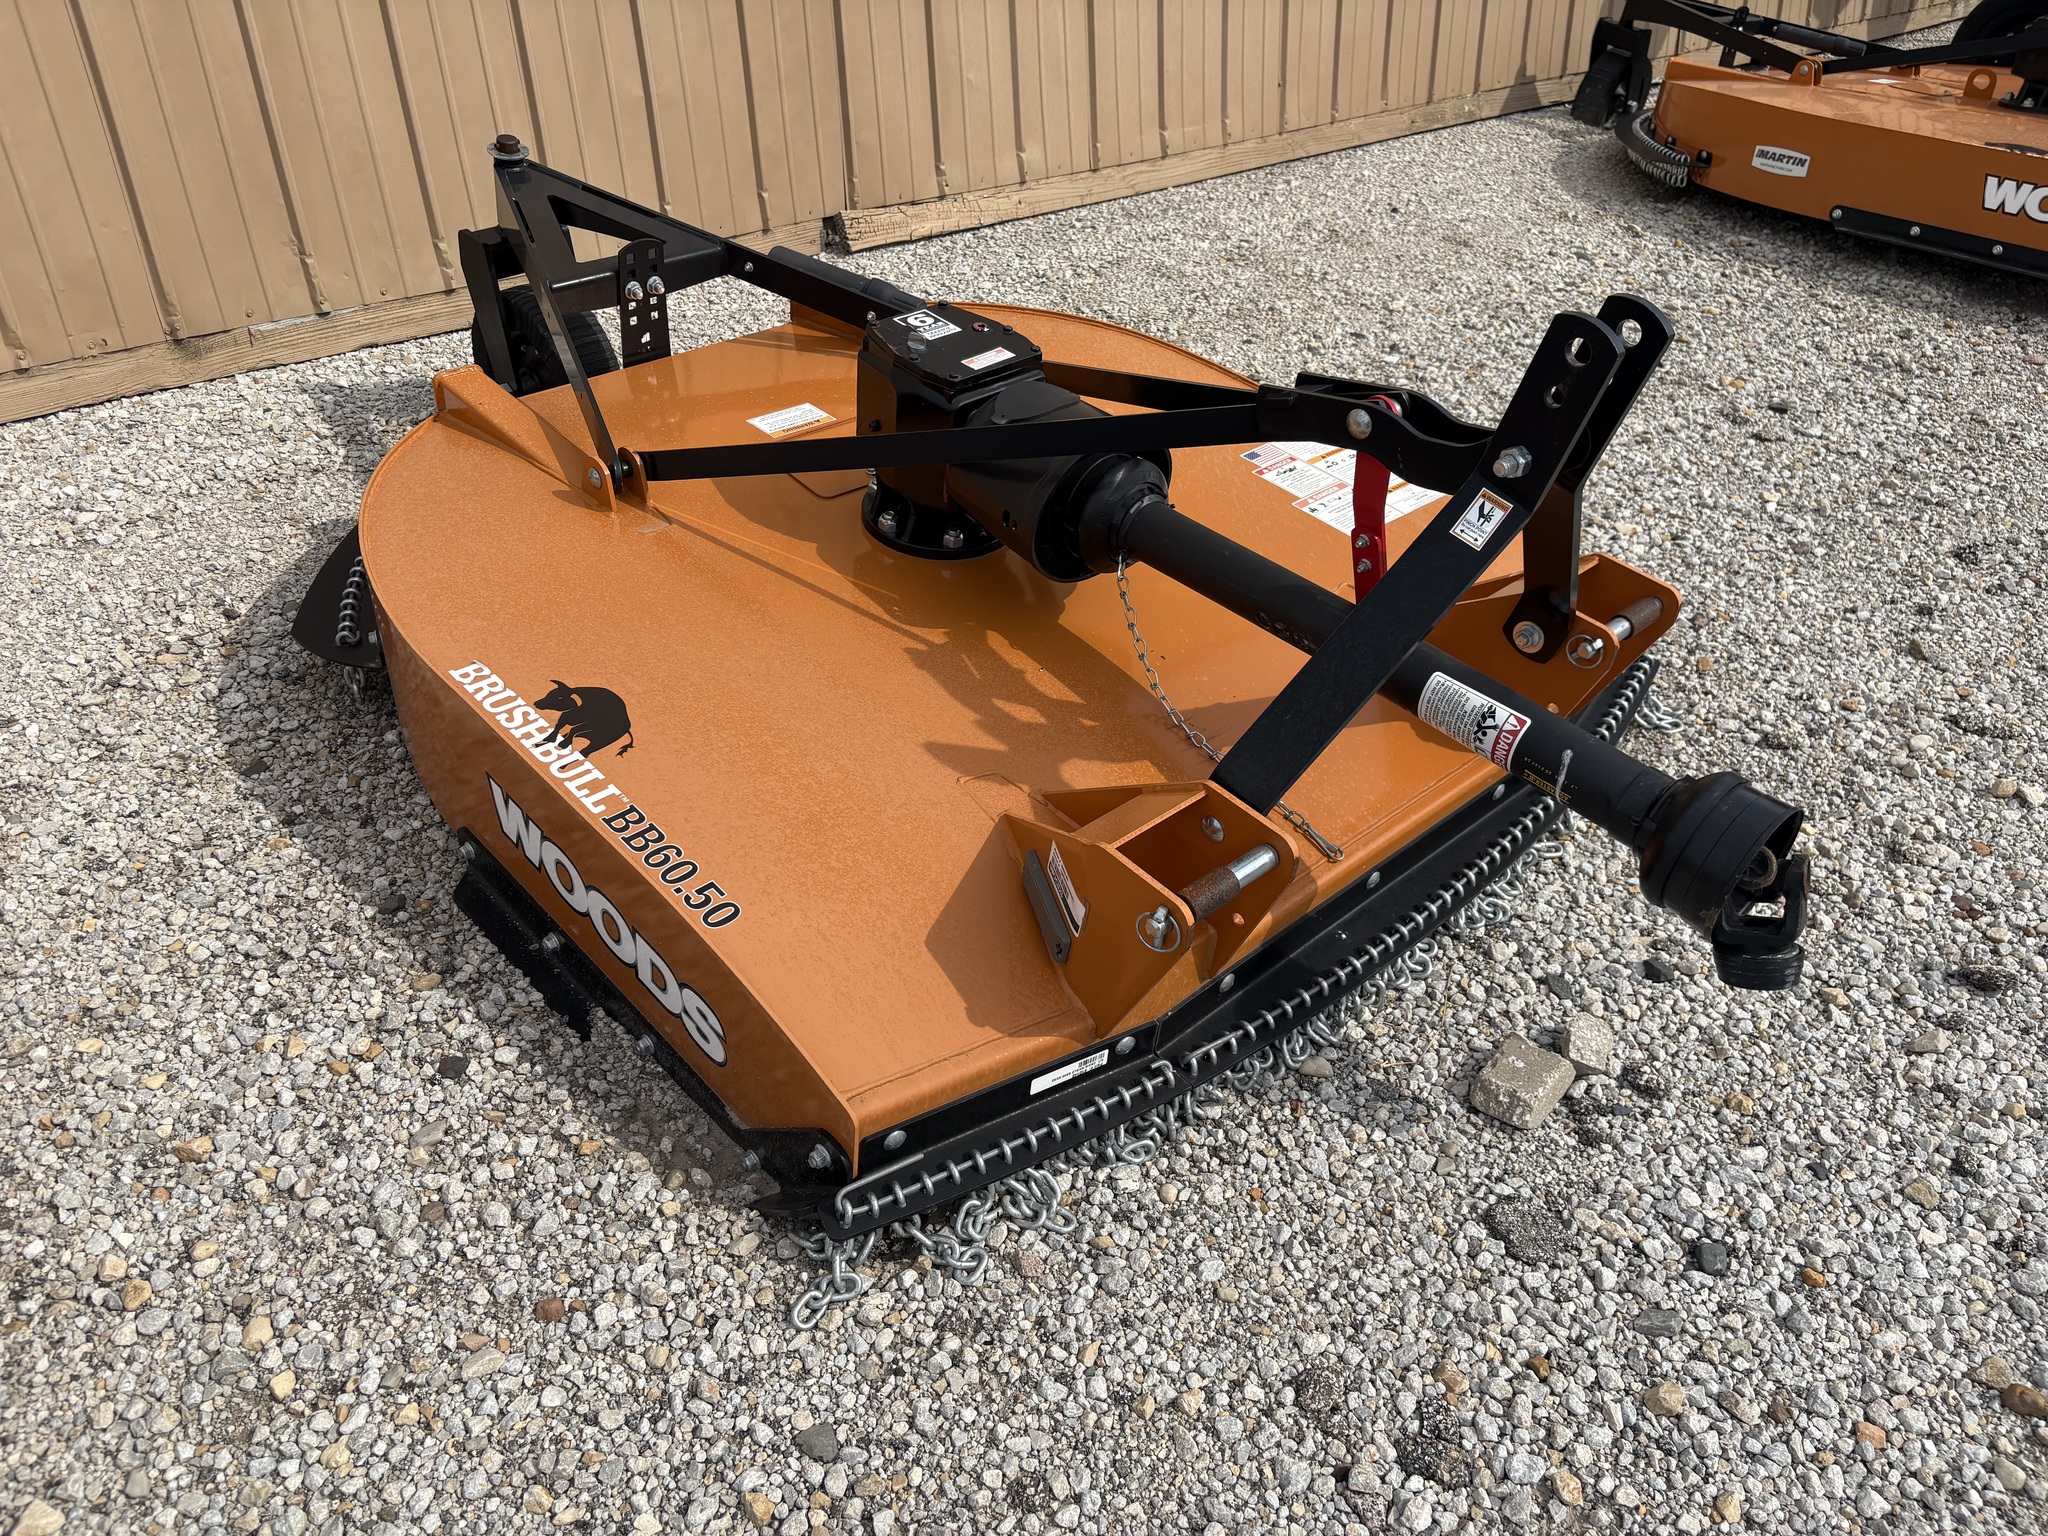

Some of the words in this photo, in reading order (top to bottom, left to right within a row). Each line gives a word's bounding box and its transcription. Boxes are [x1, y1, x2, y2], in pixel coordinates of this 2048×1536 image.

[1755, 149, 1808, 168] MARTIN
[906, 313, 935, 327] 6
[916, 321, 947, 332] YEAR
[1267, 457, 1293, 471] DANGER
[1313, 485, 1340, 501] DANGER
[1486, 495, 1509, 512] WARNING
[1459, 710, 1467, 725] KEEP
[1469, 702, 1484, 727] ROTATING
[1493, 731, 1514, 769] DANGE
[448, 660, 621, 815] BRUSHBULL
[601, 804, 742, 929] BB60.50
[485, 770, 728, 1067] WOODS
